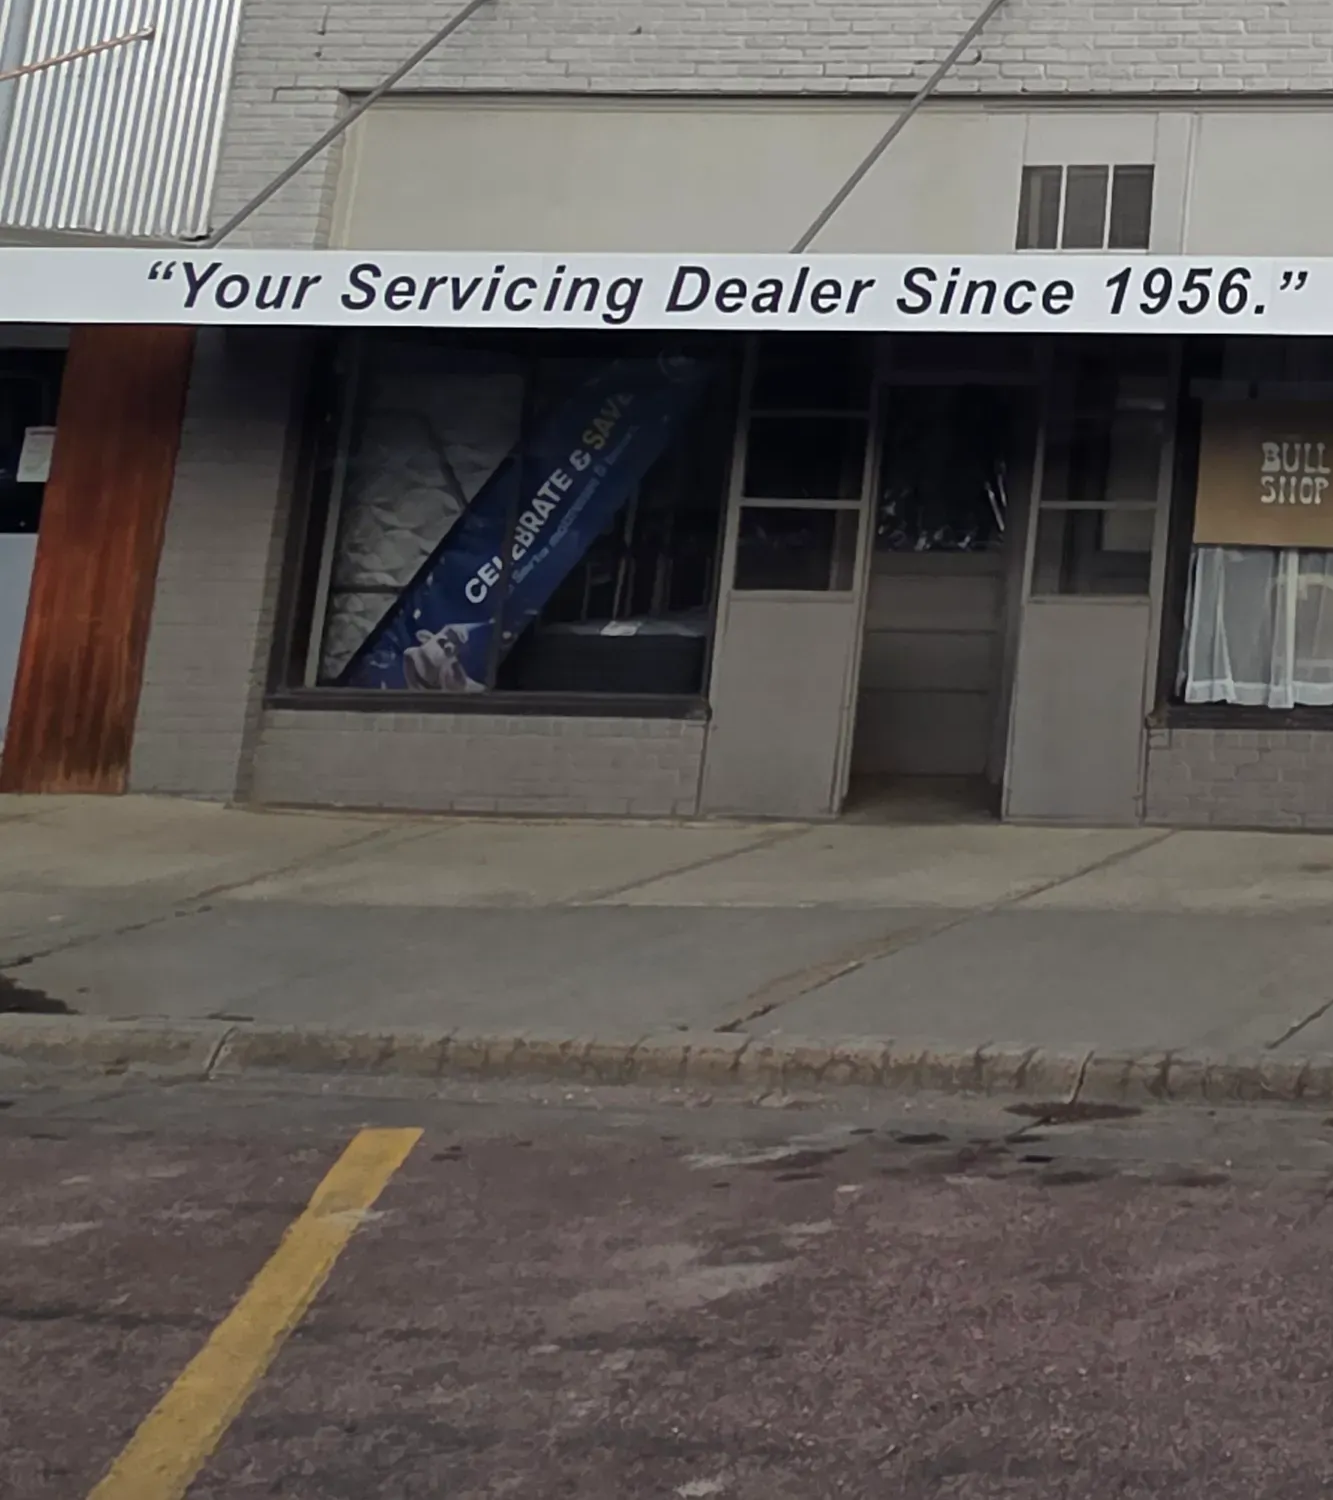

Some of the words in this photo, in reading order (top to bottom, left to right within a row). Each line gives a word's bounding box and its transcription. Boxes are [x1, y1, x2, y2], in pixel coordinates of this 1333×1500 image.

[147, 260, 322, 310] “Your
[340, 263, 644, 325] Servicing
[665, 265, 876, 314] Dealer
[896, 266, 1074, 315] Since
[1106, 266, 1308, 315] 1956.”
[569, 449, 591, 472] &
[1260, 441, 1332, 474] BULL
[1260, 475, 1330, 505] SHOP
